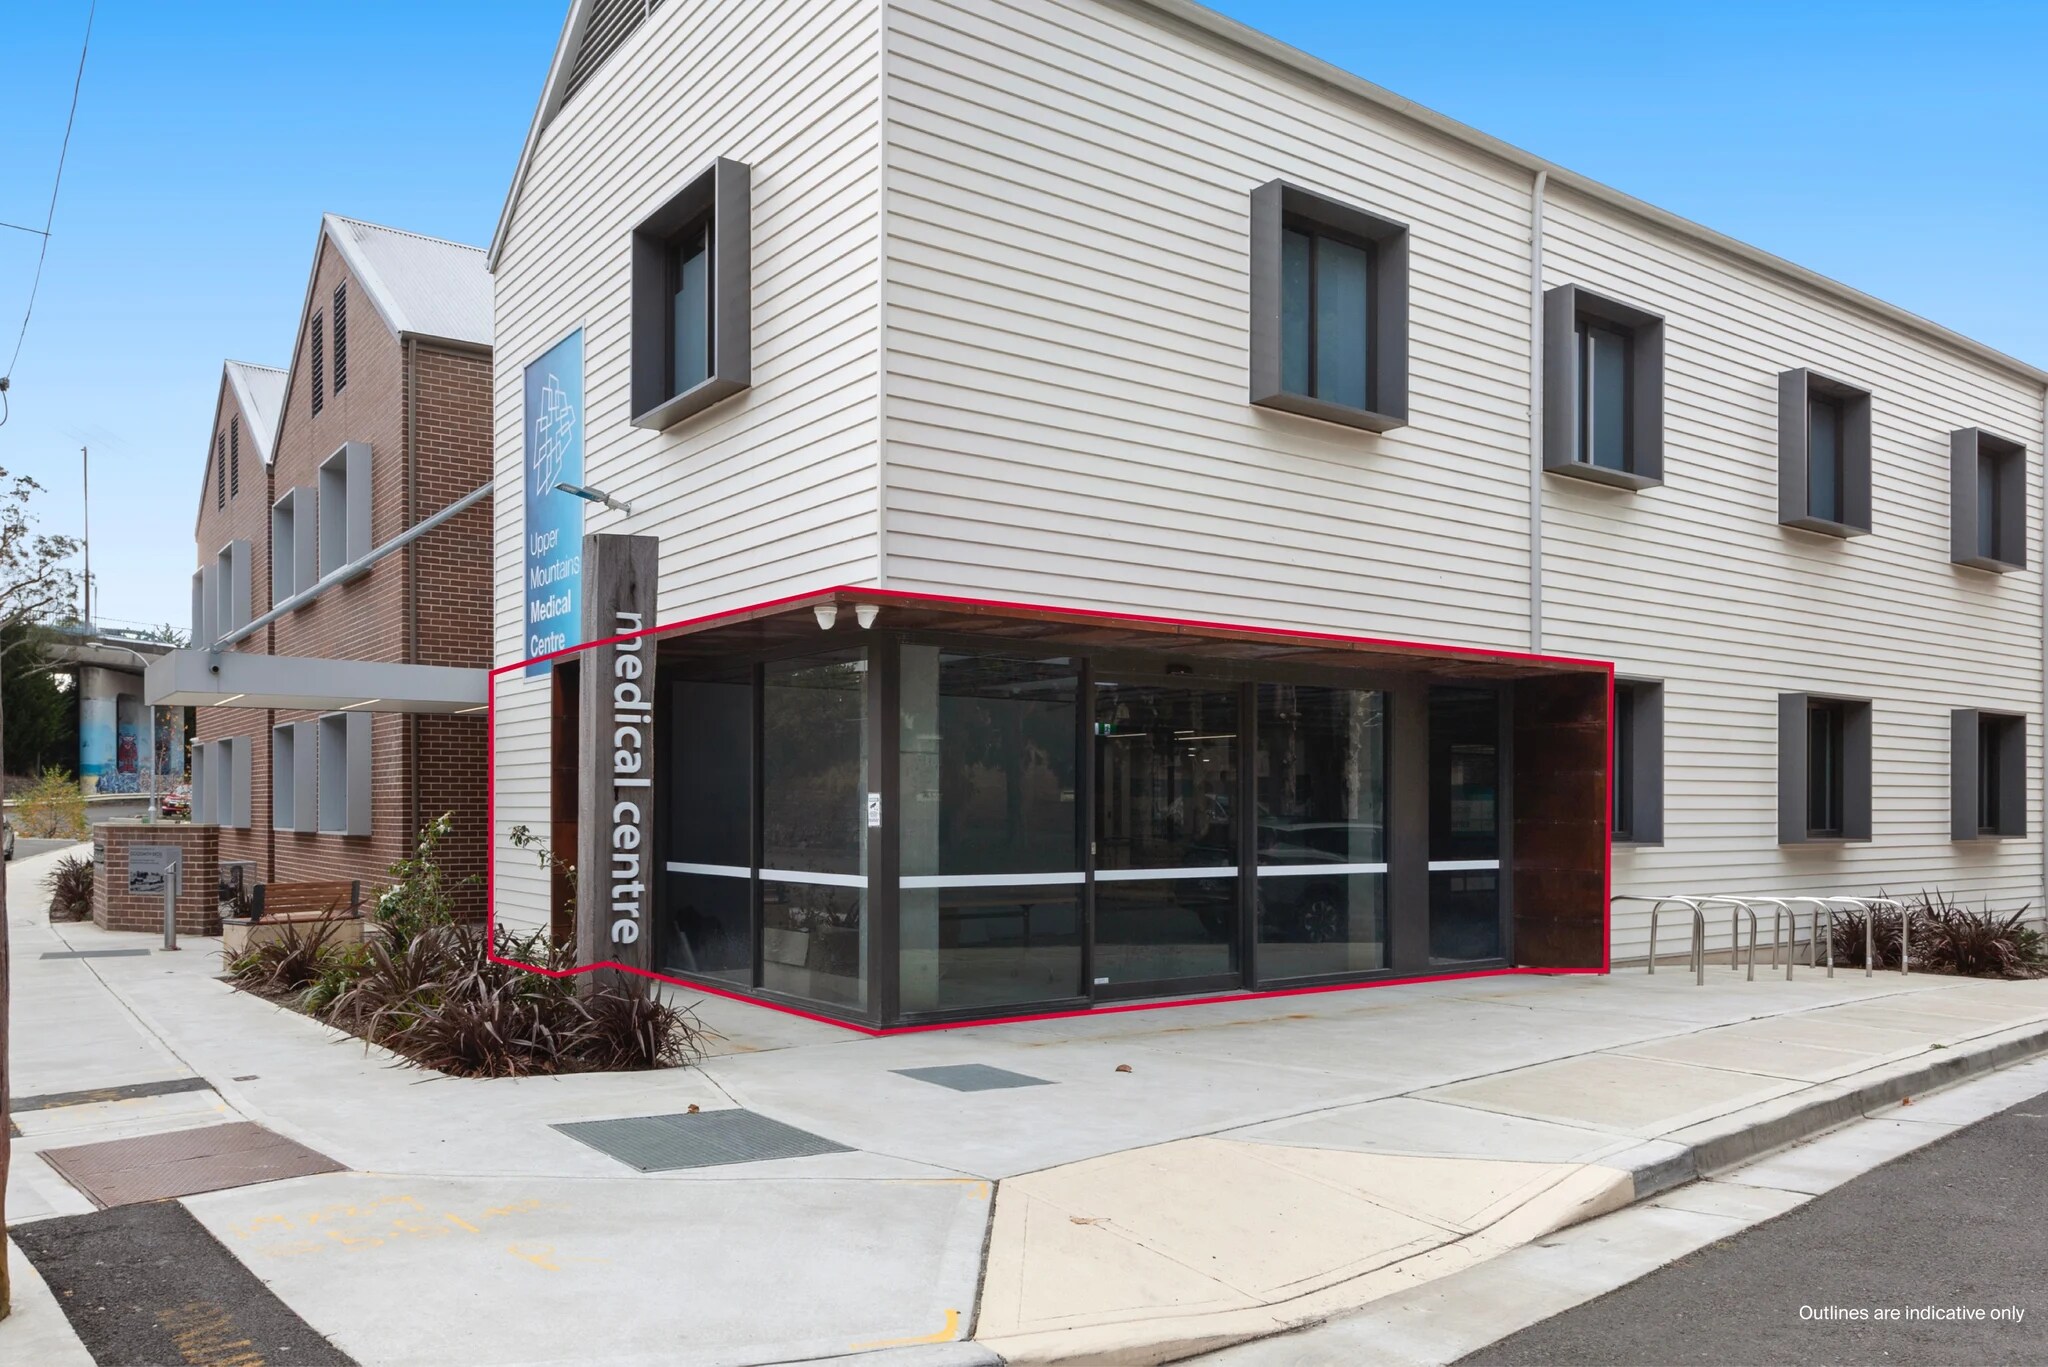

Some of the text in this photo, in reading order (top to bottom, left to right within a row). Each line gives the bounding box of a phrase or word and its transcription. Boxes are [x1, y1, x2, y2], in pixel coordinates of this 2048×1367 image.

[530, 528, 559, 558] Upper
[530, 555, 580, 589] Mountains
[530, 589, 571, 624] Medical
[530, 631, 565, 658] Centre
[611, 611, 652, 944] medical centre
